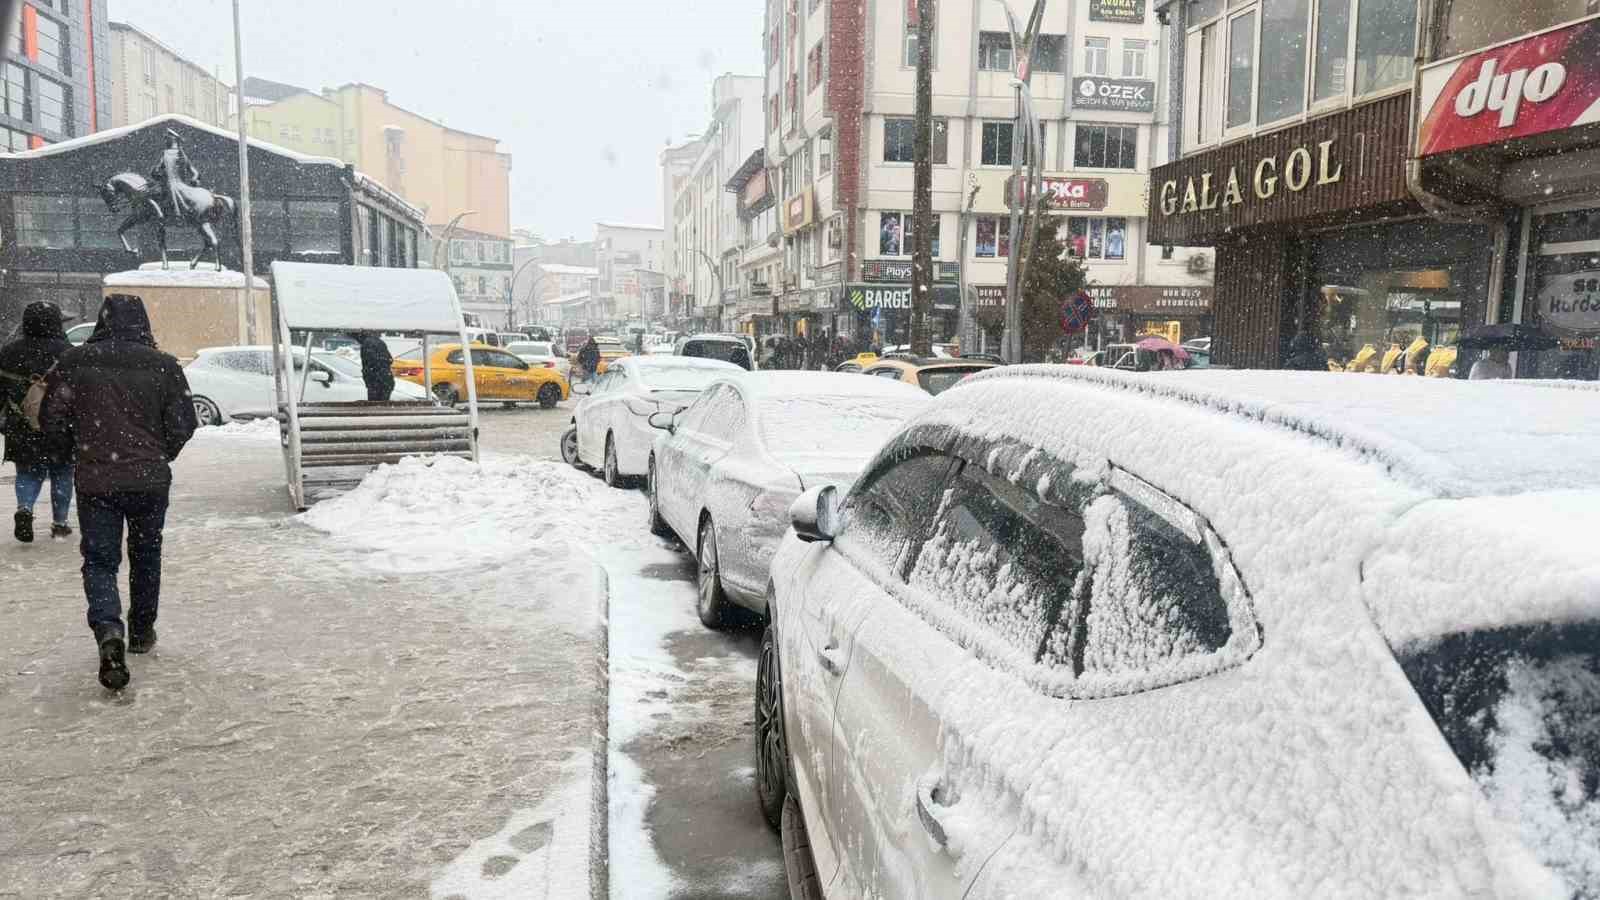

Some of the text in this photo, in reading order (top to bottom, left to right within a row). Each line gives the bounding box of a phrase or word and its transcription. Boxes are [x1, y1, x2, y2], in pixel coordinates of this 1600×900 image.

[1099, 81, 1146, 99] ÖZEK
[1455, 58, 1567, 128] dyo
[1160, 167, 1243, 216] GALA
